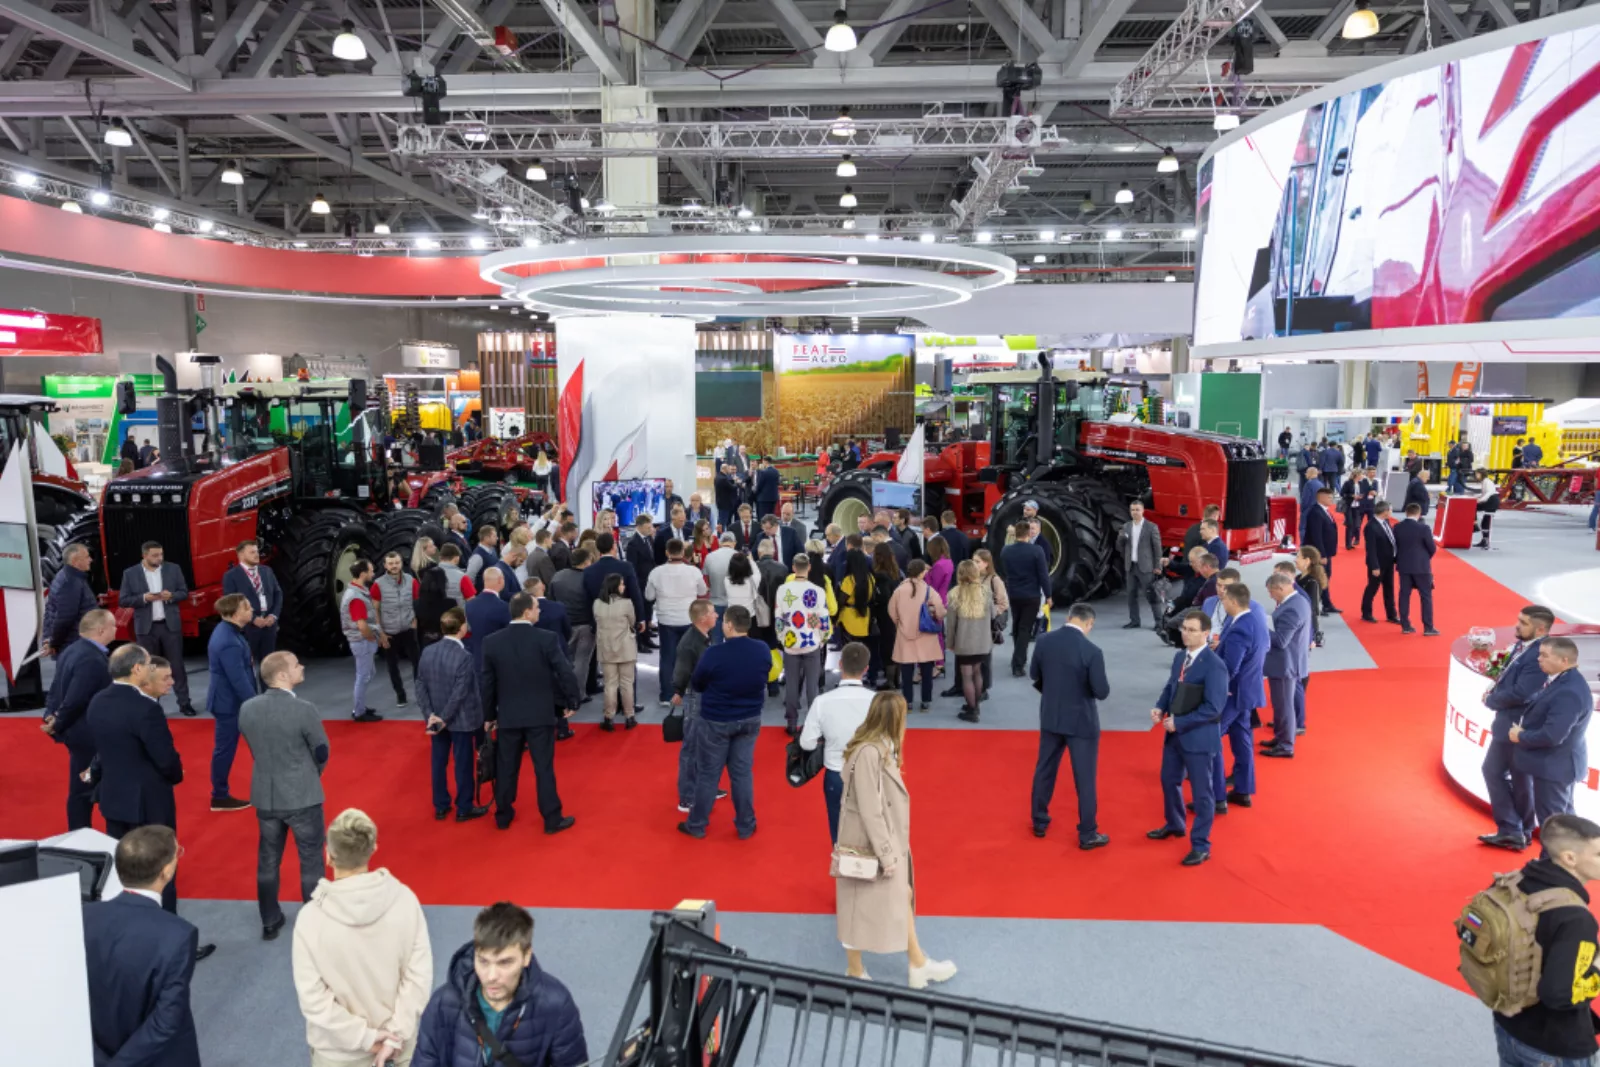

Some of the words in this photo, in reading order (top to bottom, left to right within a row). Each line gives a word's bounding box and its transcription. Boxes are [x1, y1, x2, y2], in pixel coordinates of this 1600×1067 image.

[793, 344, 829, 355] FEAT
[811, 355, 848, 363] AGRO
[242, 495, 259, 510] 2375
